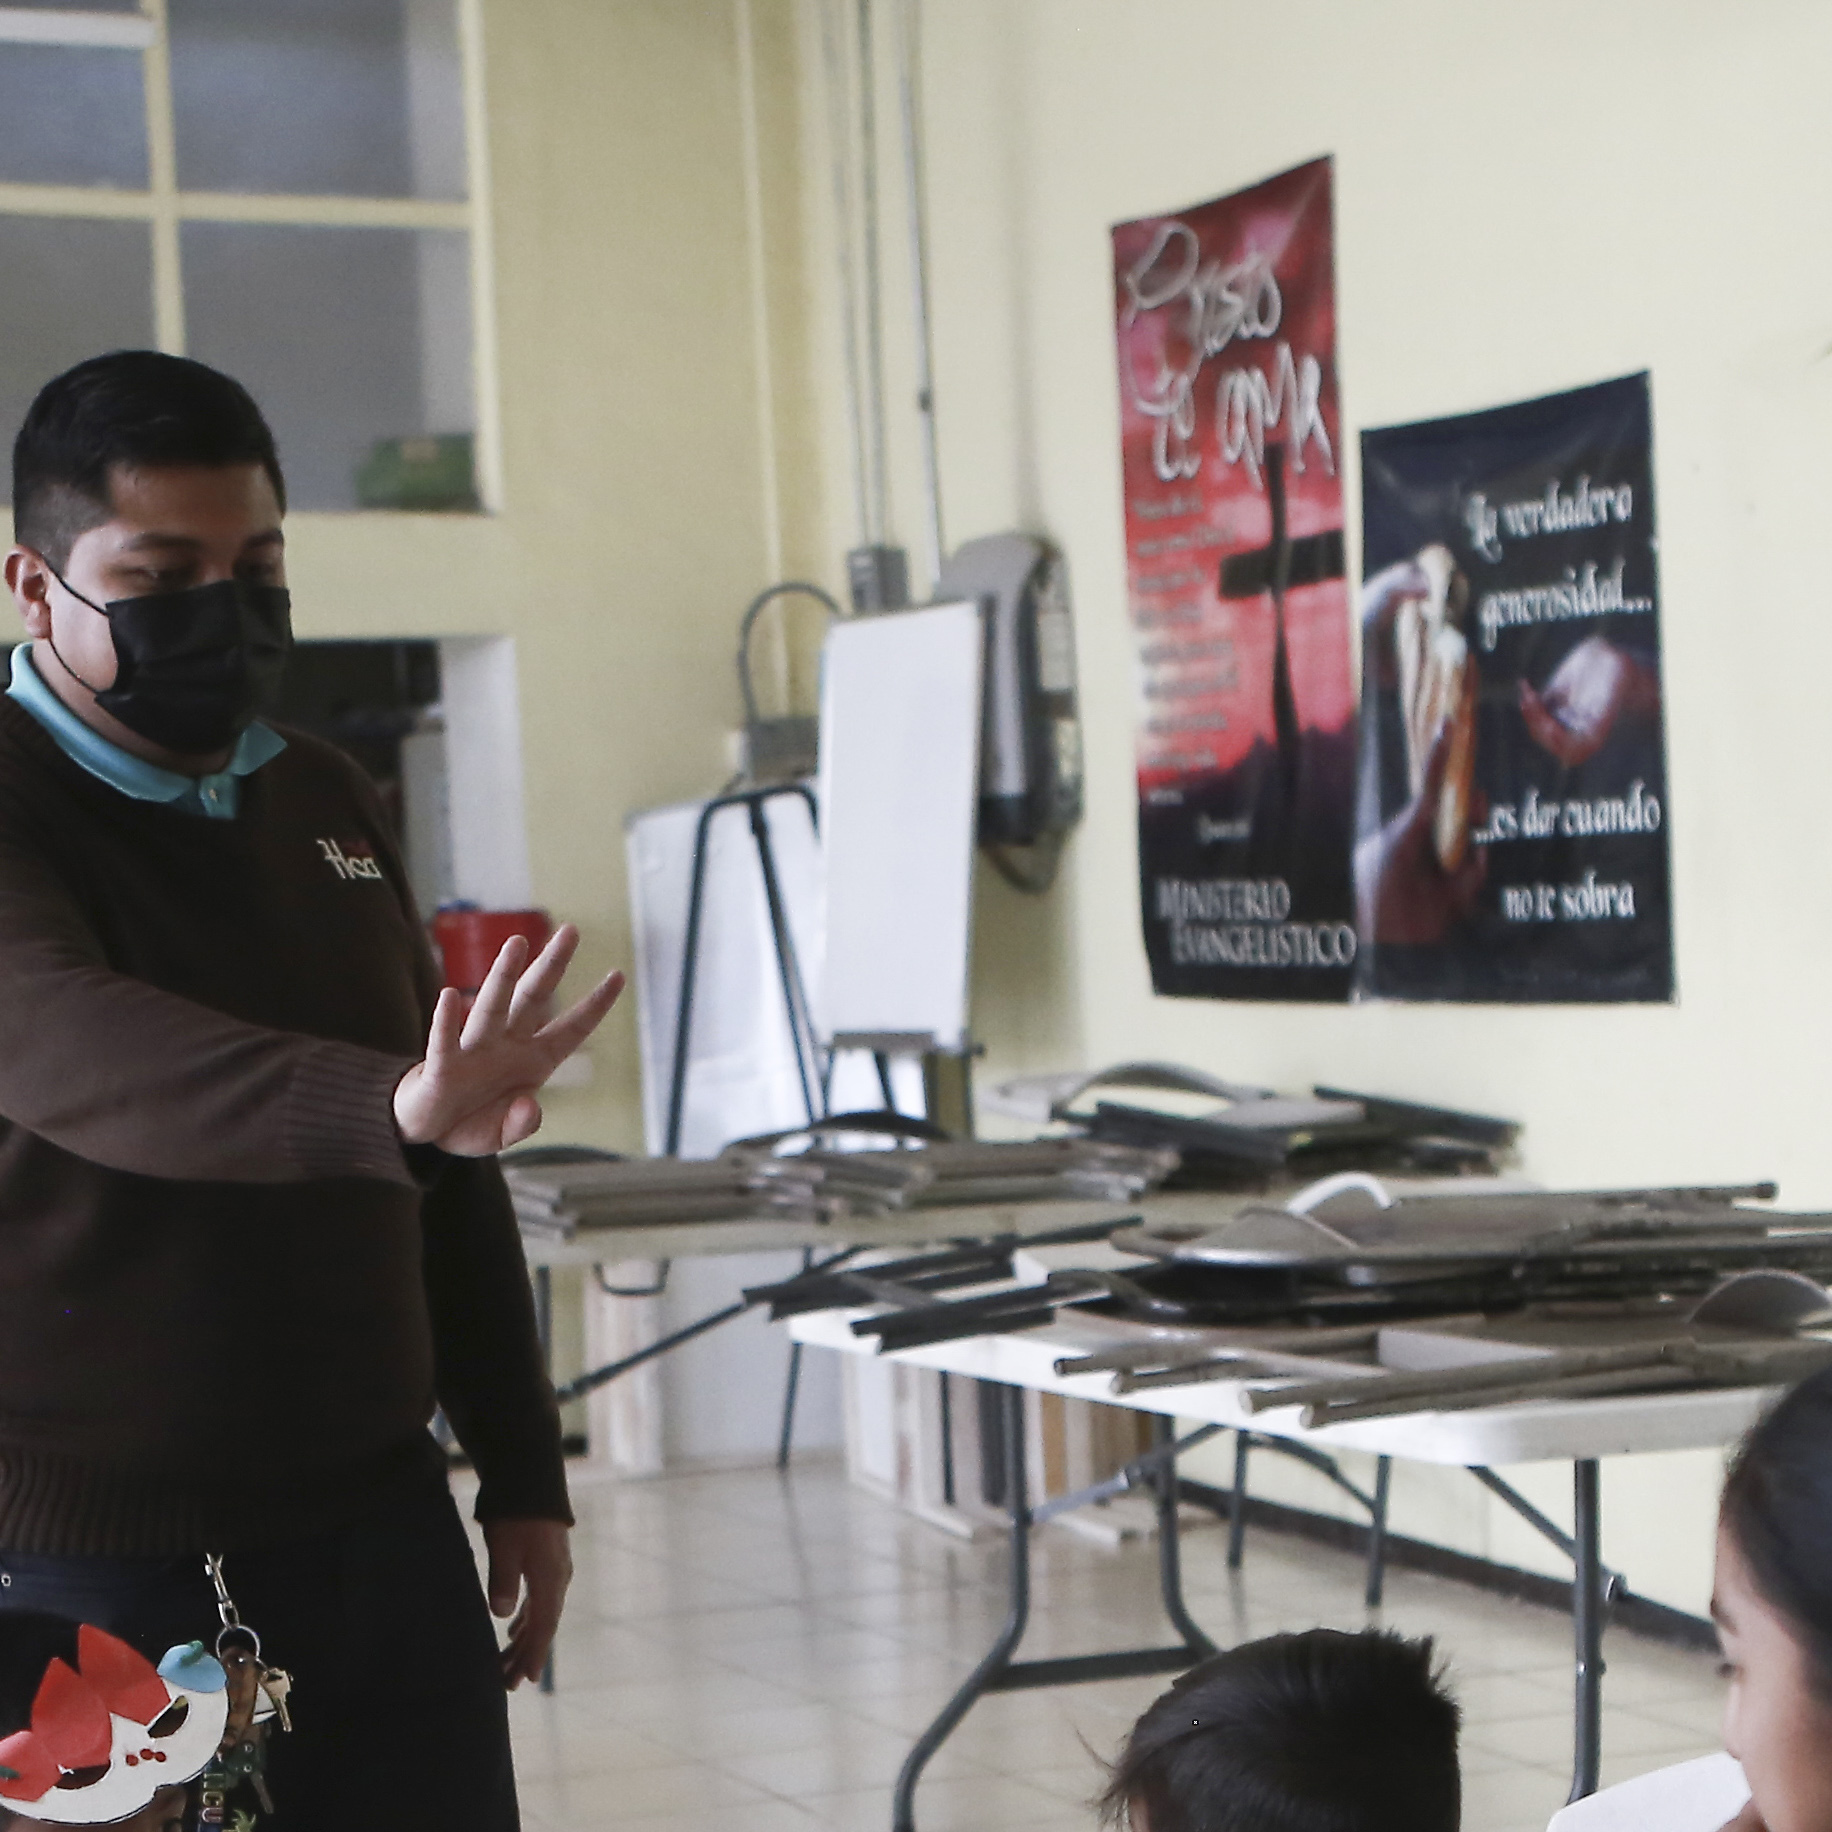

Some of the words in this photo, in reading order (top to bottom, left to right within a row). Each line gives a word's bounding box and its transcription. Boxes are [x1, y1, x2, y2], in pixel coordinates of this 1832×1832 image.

[1521, 785, 1561, 839] dar
[1561, 777, 1661, 837] cuando
[1157, 877, 1292, 922] MINISTERIO
[1503, 884, 1534, 922] no
[1561, 867, 1636, 920] sobra
